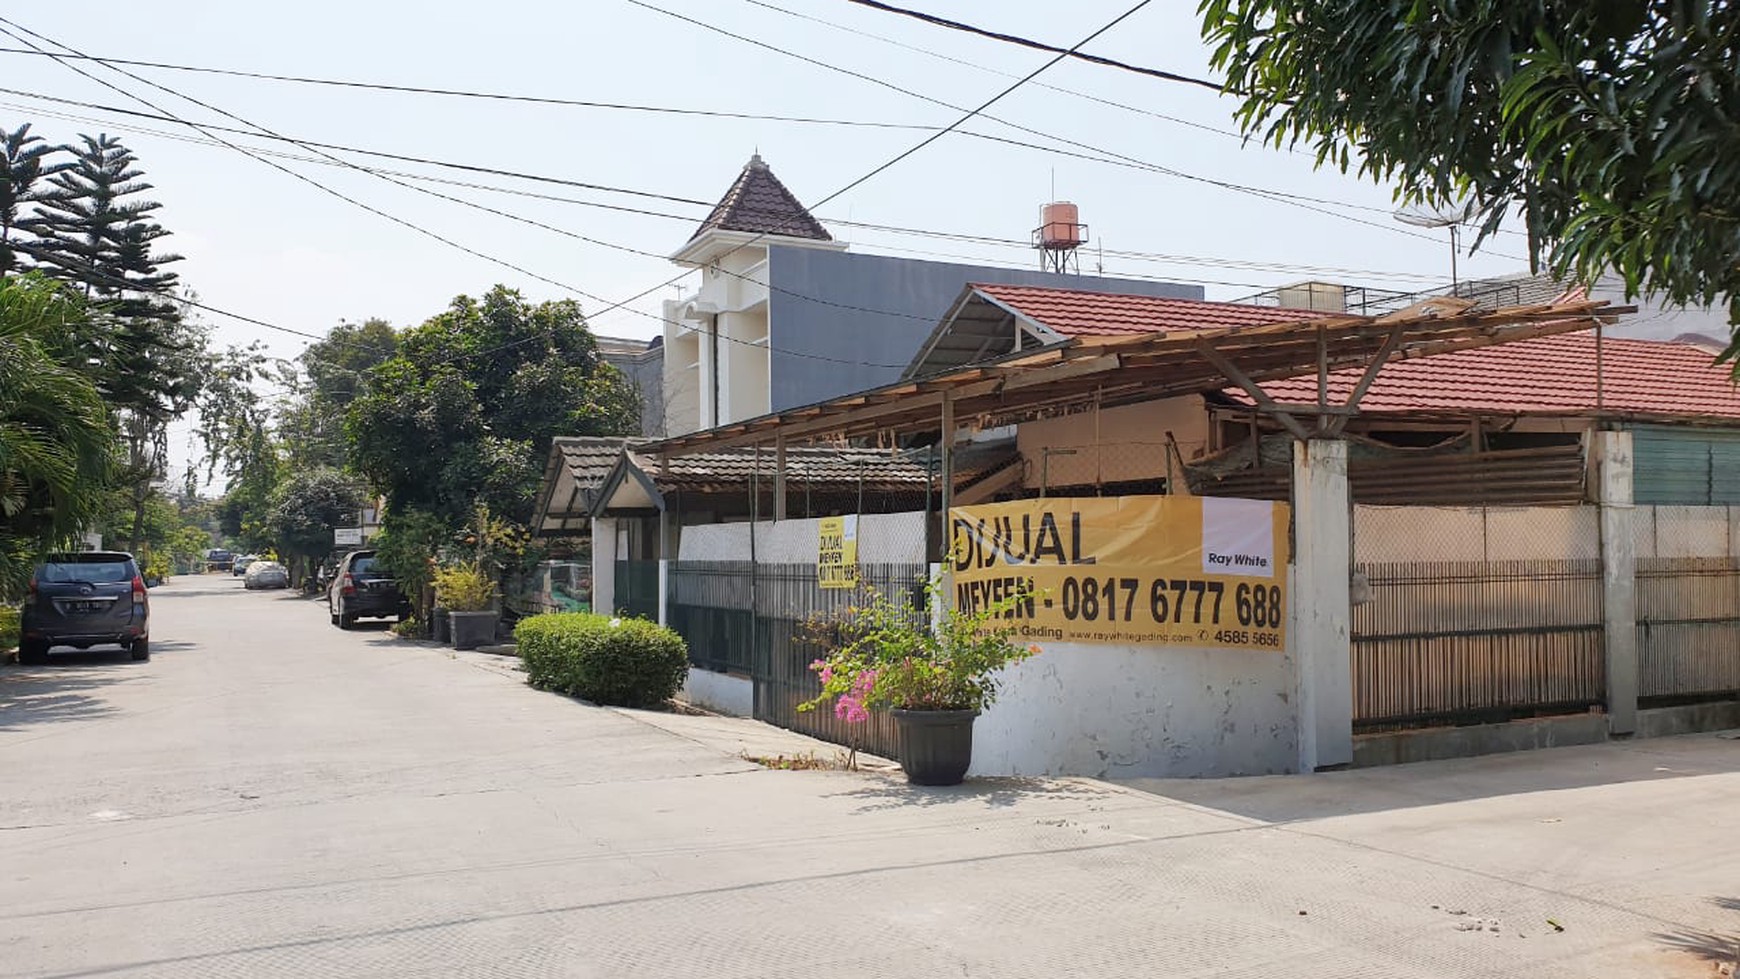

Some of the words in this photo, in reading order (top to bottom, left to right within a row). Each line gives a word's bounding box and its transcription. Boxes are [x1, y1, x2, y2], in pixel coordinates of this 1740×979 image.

[953, 512, 1097, 572] DIJUAL
[1208, 552, 1233, 567] Ray
[1234, 554, 1268, 567] White
[1062, 576, 1139, 621] 0817
[1151, 578, 1225, 625] 6777
[1236, 582, 1282, 629] 688
[1021, 625, 1063, 639] Gading
[1214, 630, 1249, 645] 4585
[1252, 632, 1279, 647] 5656
